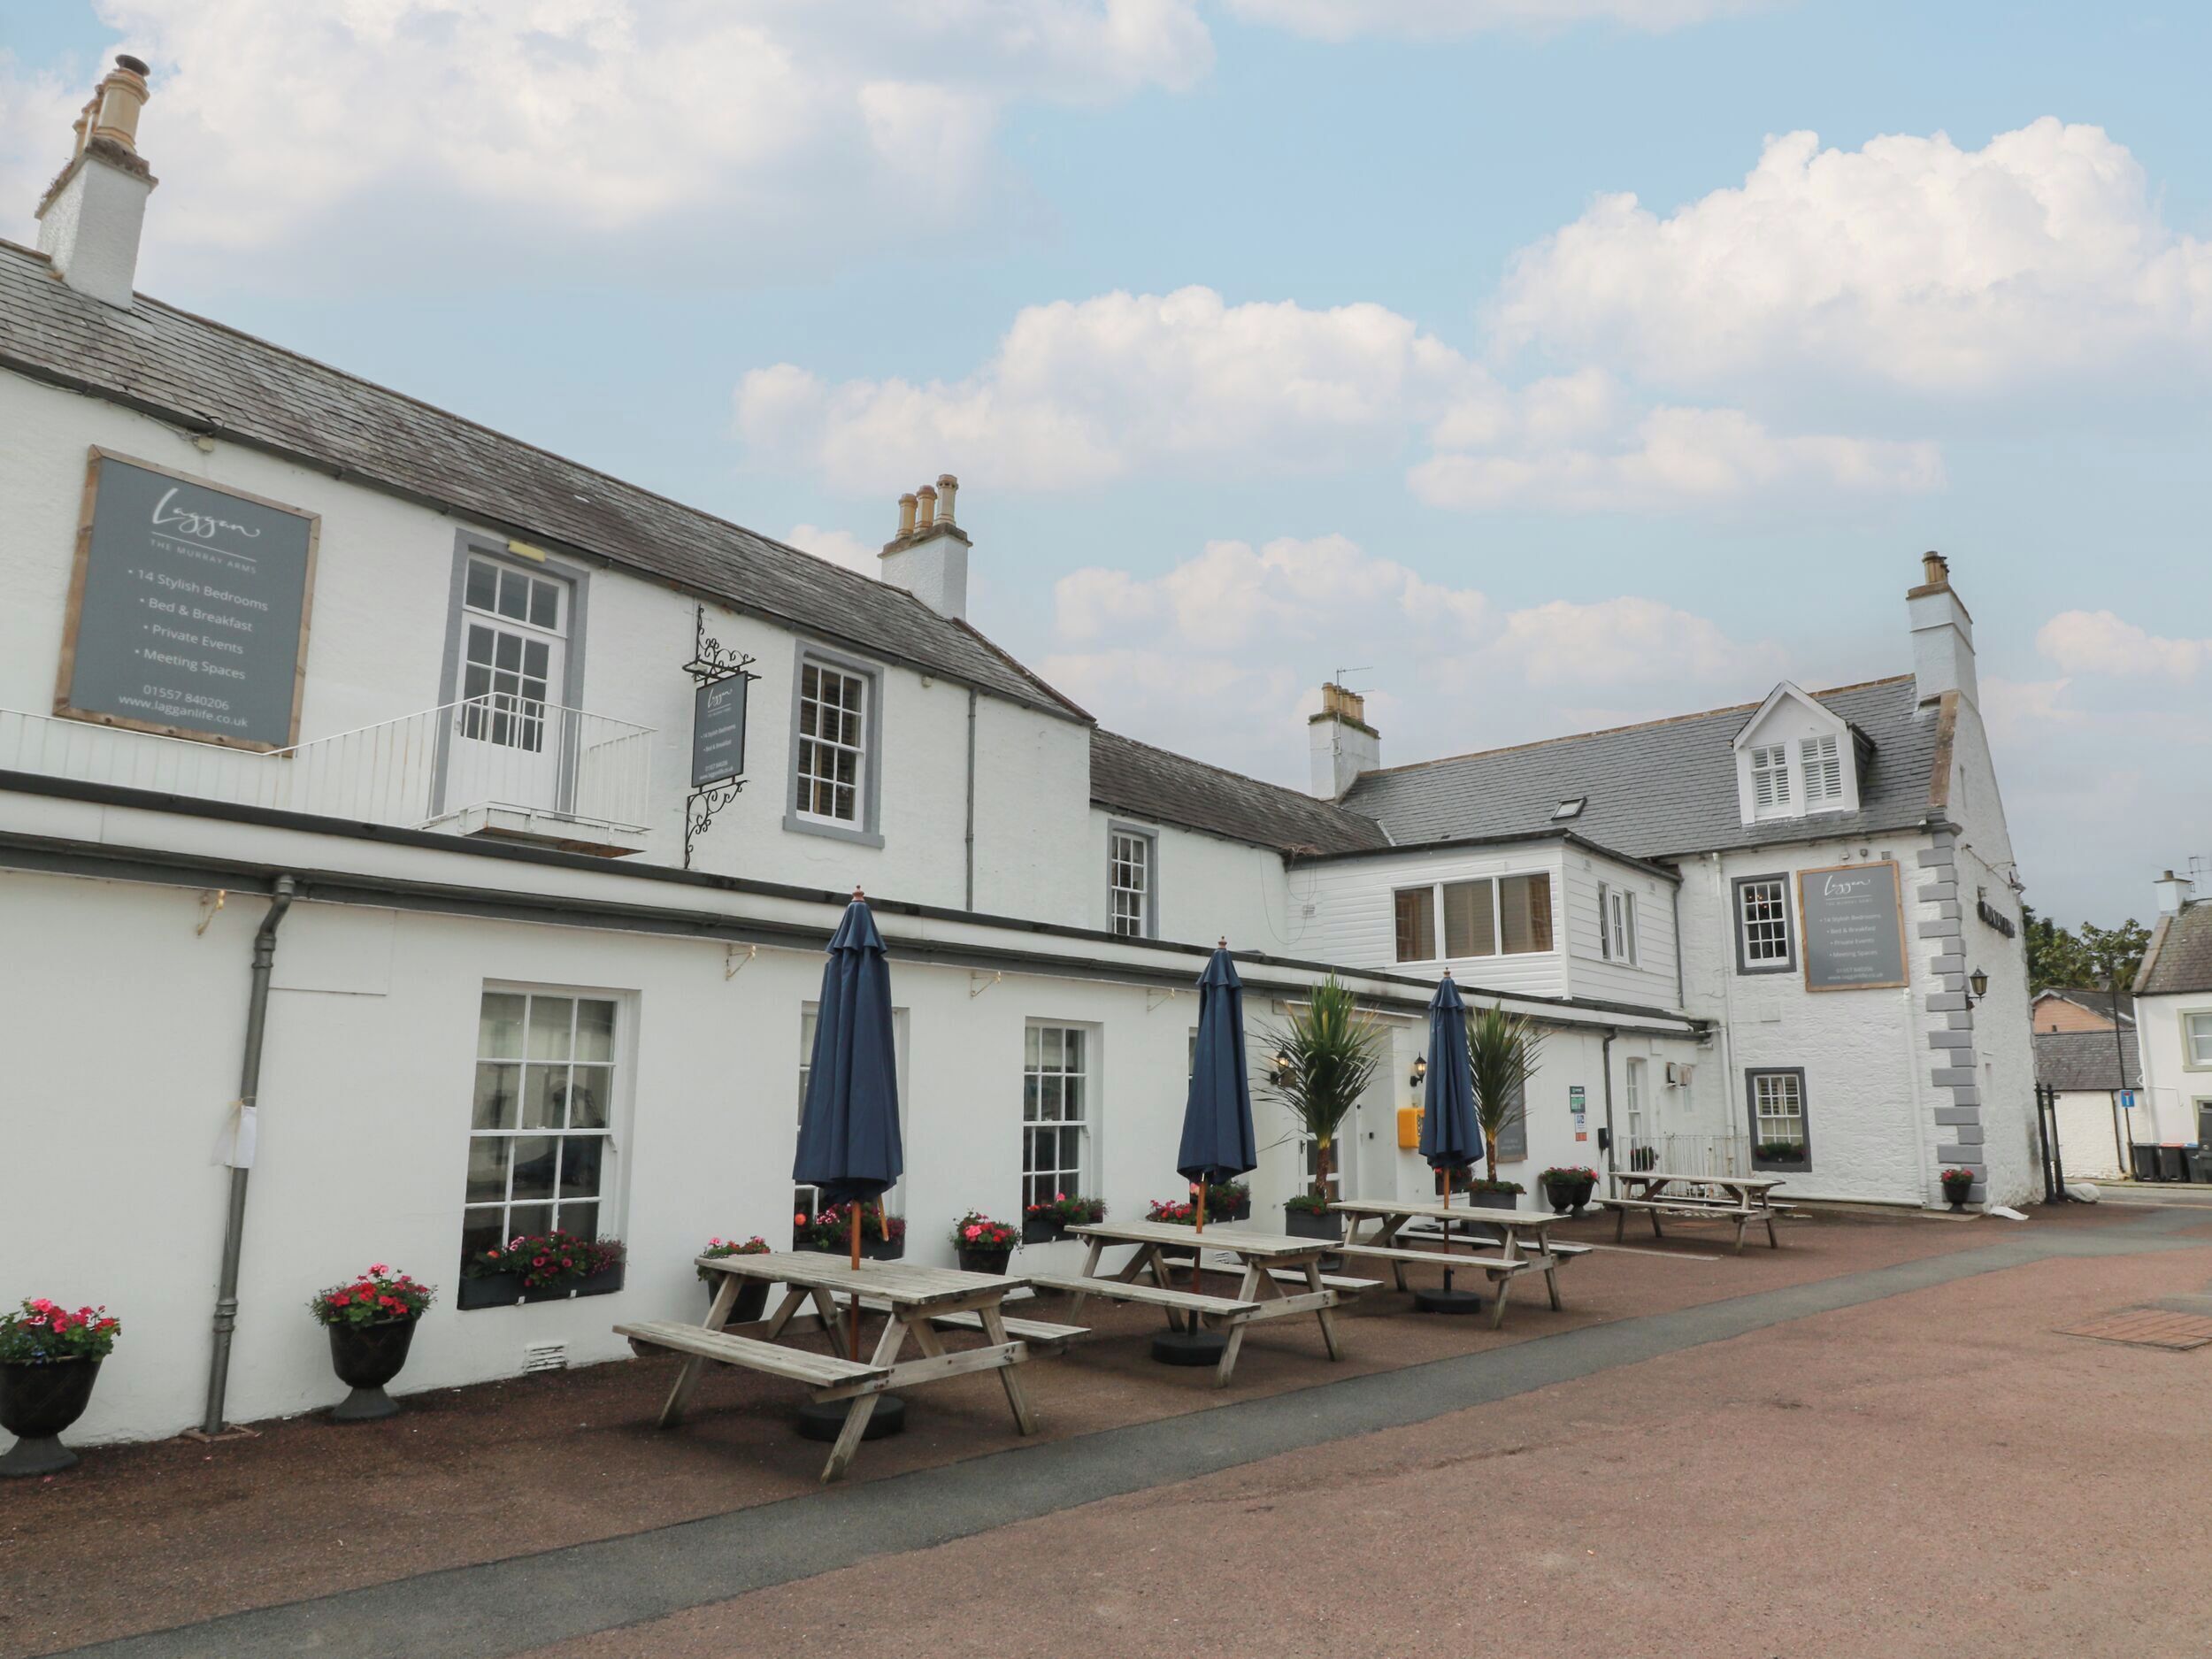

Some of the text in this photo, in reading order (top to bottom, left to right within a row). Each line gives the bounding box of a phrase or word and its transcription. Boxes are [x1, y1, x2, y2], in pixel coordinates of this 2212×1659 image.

[152, 488, 261, 539] Laggan
[150, 540, 257, 573] THE MURRAY ARMS
[138, 570, 269, 611] 14 Stylish Bedrooms
[150, 598, 252, 632] Bed & Breakfast
[153, 625, 243, 655] Private Events
[144, 649, 246, 680] Meeting Spaces
[119, 695, 248, 727] www.lagganlife.co.uk
[143, 685, 229, 710] 01557 840206
